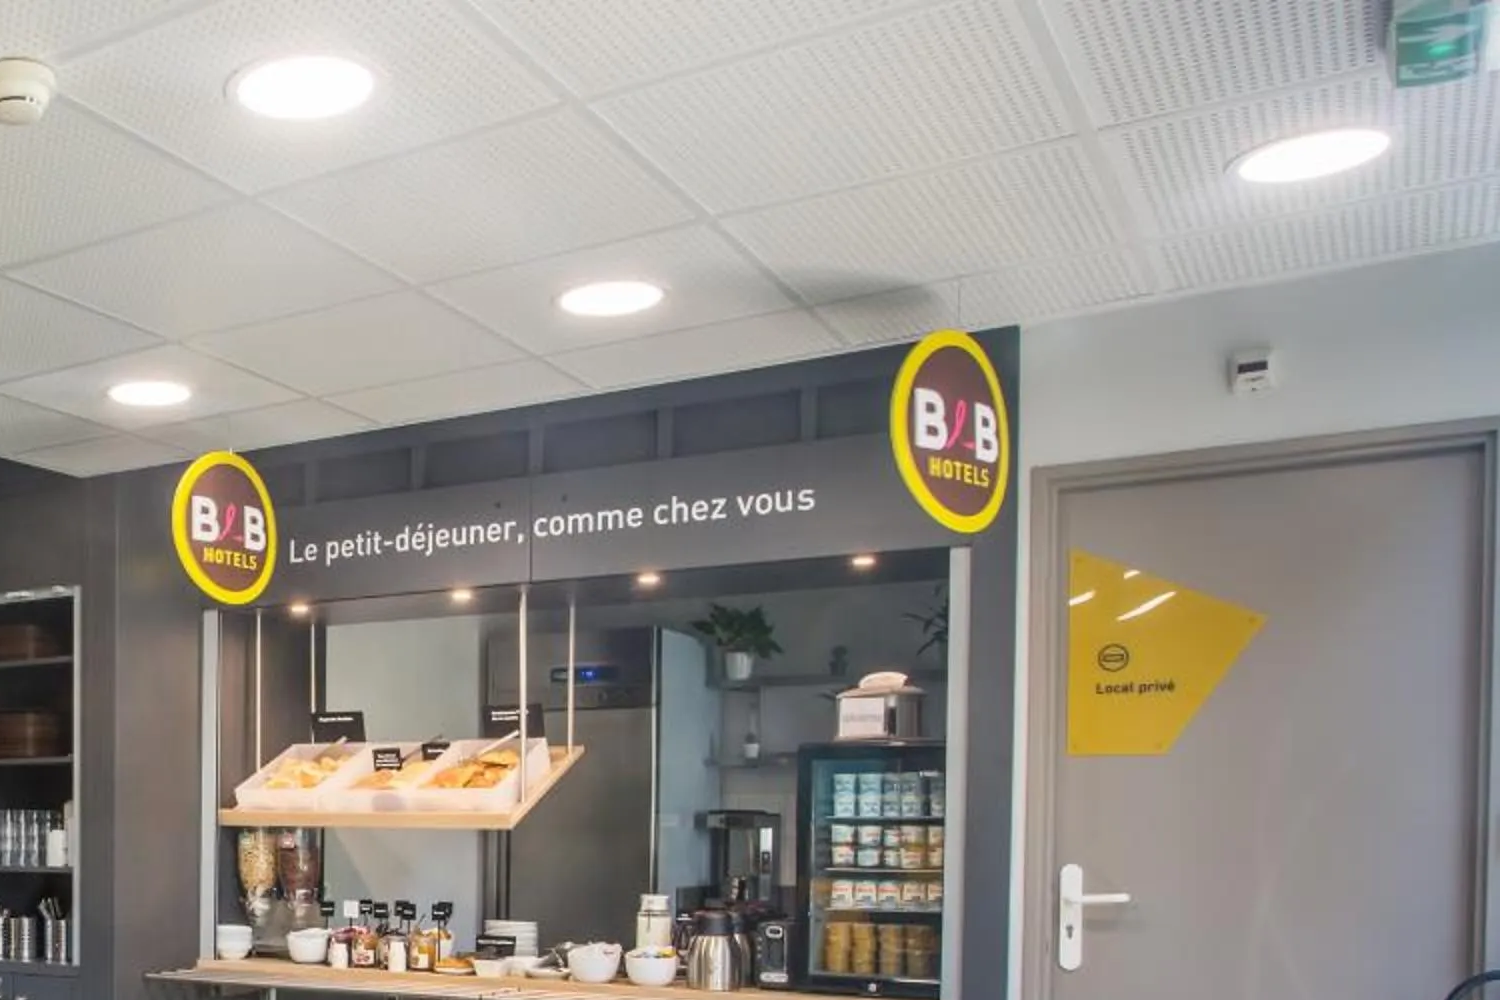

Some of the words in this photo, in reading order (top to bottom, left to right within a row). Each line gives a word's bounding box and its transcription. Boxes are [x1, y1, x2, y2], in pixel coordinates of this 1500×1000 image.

[928, 455, 989, 488] HOTELS
[289, 539, 318, 564] Le
[325, 520, 525, 567] petit-déjeuner,
[533, 507, 644, 537] comme
[653, 495, 728, 525] chez
[735, 488, 816, 517] vous
[203, 546, 258, 571] HOTELS
[1095, 682, 1134, 695] Local
